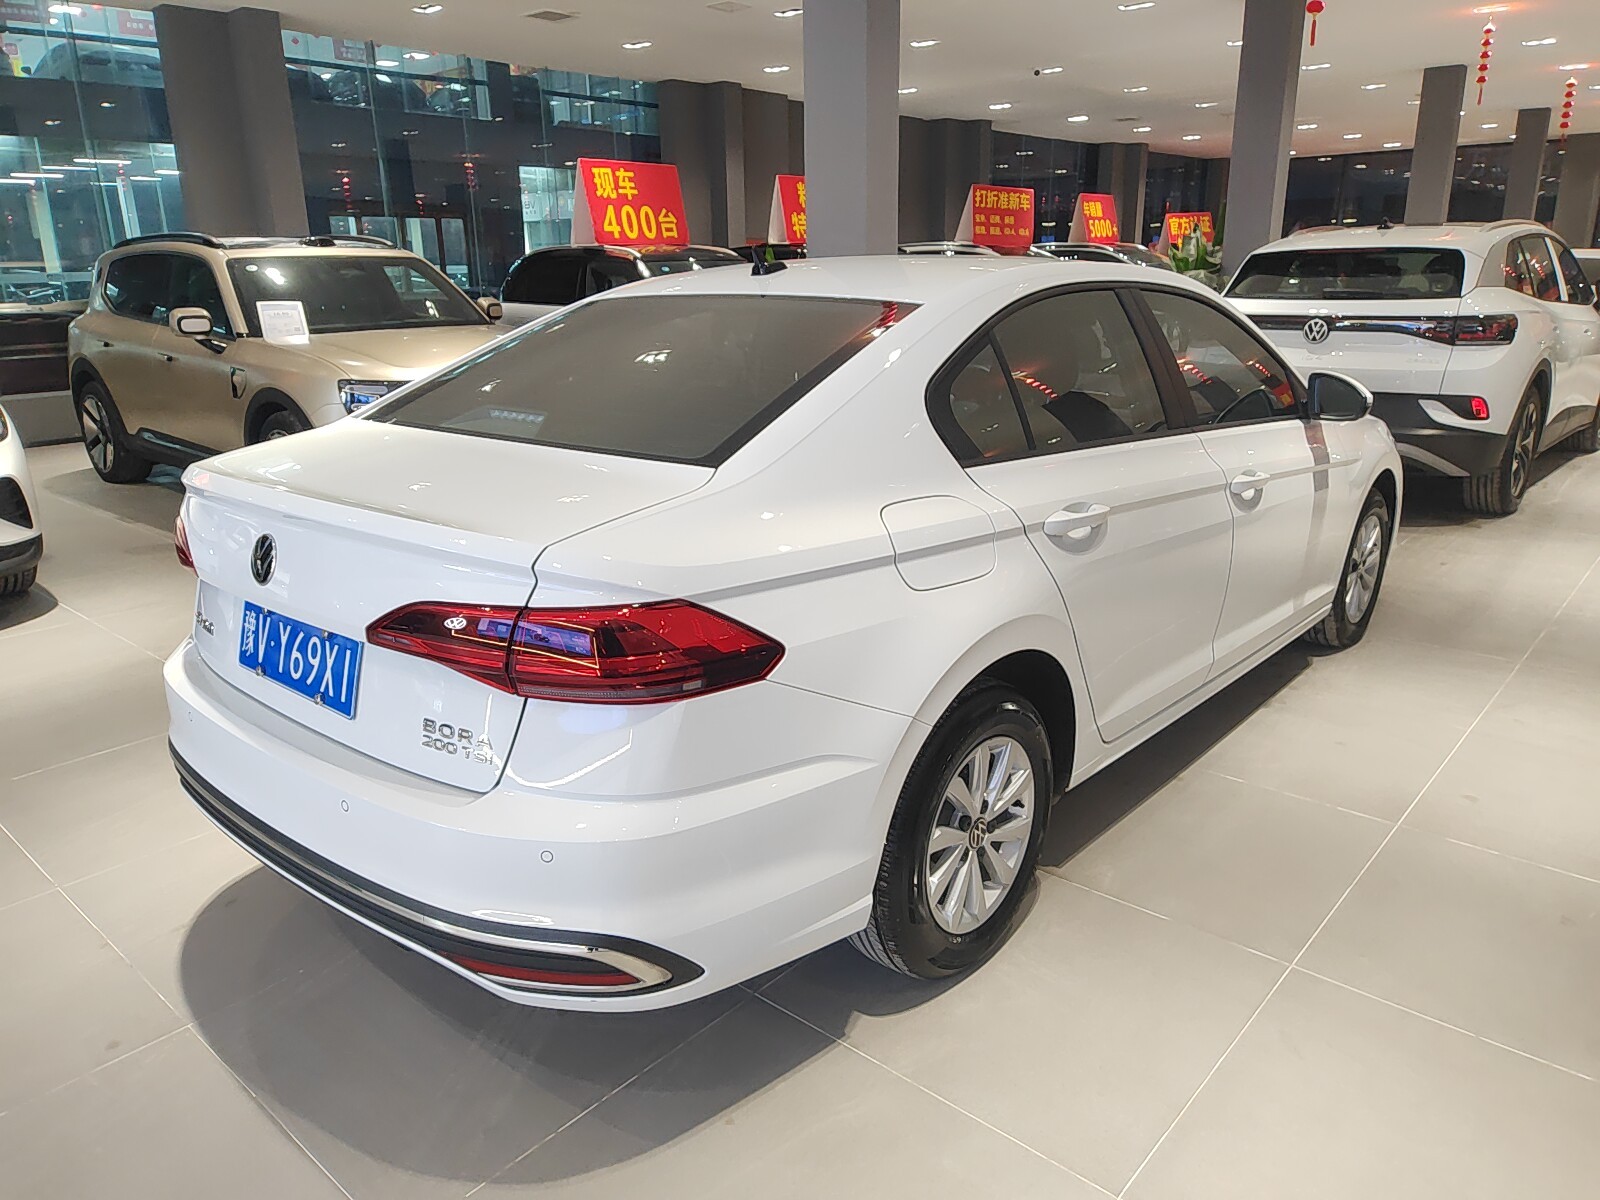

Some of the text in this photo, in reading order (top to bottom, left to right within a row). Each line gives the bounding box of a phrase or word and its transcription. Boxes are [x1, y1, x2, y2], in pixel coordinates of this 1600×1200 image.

[591, 167, 638, 201] 现车
[975, 189, 1031, 211] 打折准新车
[603, 204, 678, 240] 400台
[421, 734, 494, 766] 200 TSI
[422, 717, 494, 750] BORA
